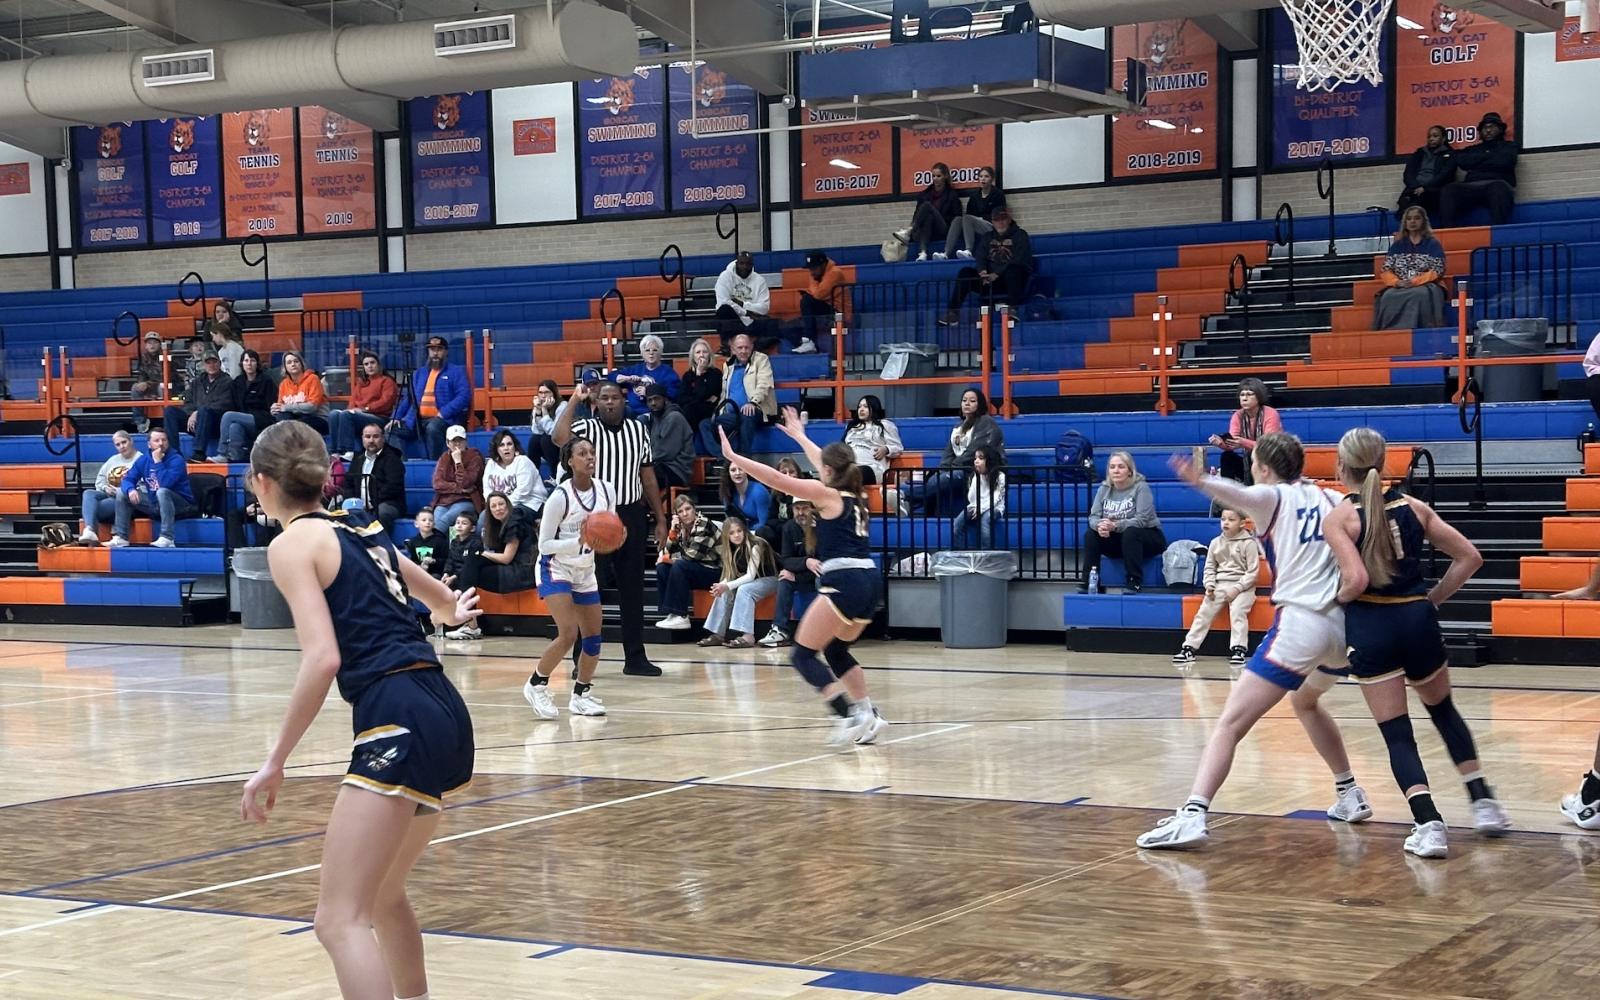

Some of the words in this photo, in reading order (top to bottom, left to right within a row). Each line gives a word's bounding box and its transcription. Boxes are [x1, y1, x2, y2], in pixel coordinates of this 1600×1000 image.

[1423, 35, 1458, 47] LADY
[1462, 32, 1488, 43] CAT
[1430, 44, 1479, 65] GOLF
[1411, 79, 1466, 94] DISTRICT
[1420, 92, 1491, 108] RUNNER-UP
[678, 114, 749, 135] SWIMMING
[588, 123, 657, 143] SWIMMING
[813, 132, 855, 145] DISTRICT
[1444, 126, 1477, 144] 019
[417, 137, 481, 156] SWIMMING
[821, 143, 872, 157] CHAMPION
[920, 136, 976, 149] RUNNER-UP
[1288, 137, 1370, 158] 2017-2018
[239, 154, 280, 169] TENNIS
[316, 148, 358, 163] TENNIS
[1128, 149, 1202, 170] 2018-2019
[98, 166, 125, 181] GOLF
[170, 161, 198, 176] GOLF
[600, 164, 647, 177] CHAMPION
[815, 174, 880, 192] 2016-2017
[594, 191, 654, 209] 2017-2018
[684, 184, 745, 203] 2018-2019
[248, 217, 276, 231] 2018
[325, 212, 353, 226] 2019
[173, 222, 200, 235] 2019
